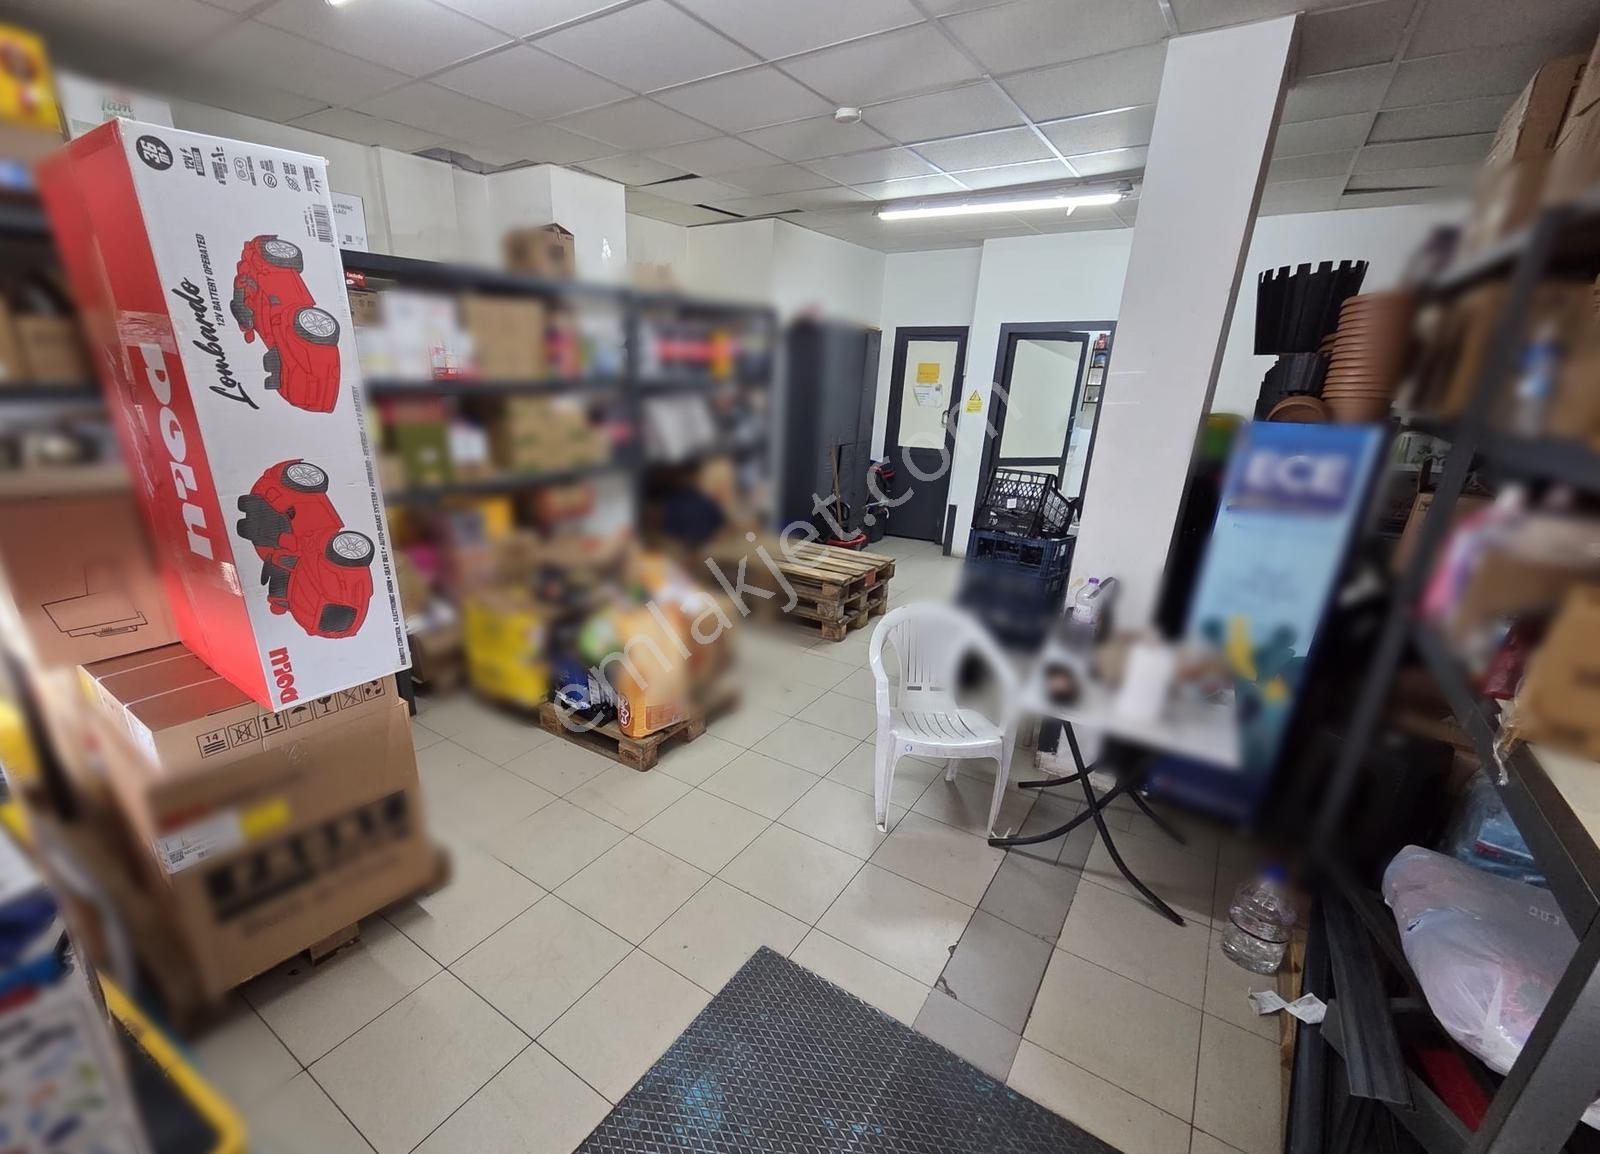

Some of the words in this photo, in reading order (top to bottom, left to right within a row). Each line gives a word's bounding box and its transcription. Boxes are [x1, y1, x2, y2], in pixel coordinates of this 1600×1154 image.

[139, 140, 160, 163] 36
[183, 154, 195, 170] 12V
[195, 233, 213, 275] OPERATED
[205, 276, 221, 311] BATTERY
[214, 311, 225, 326] 12V
[172, 277, 260, 410] Lombardo
[371, 493, 380, 513] SYSTEM
[380, 550, 388, 562] BELT
[205, 733, 219, 743] 14
